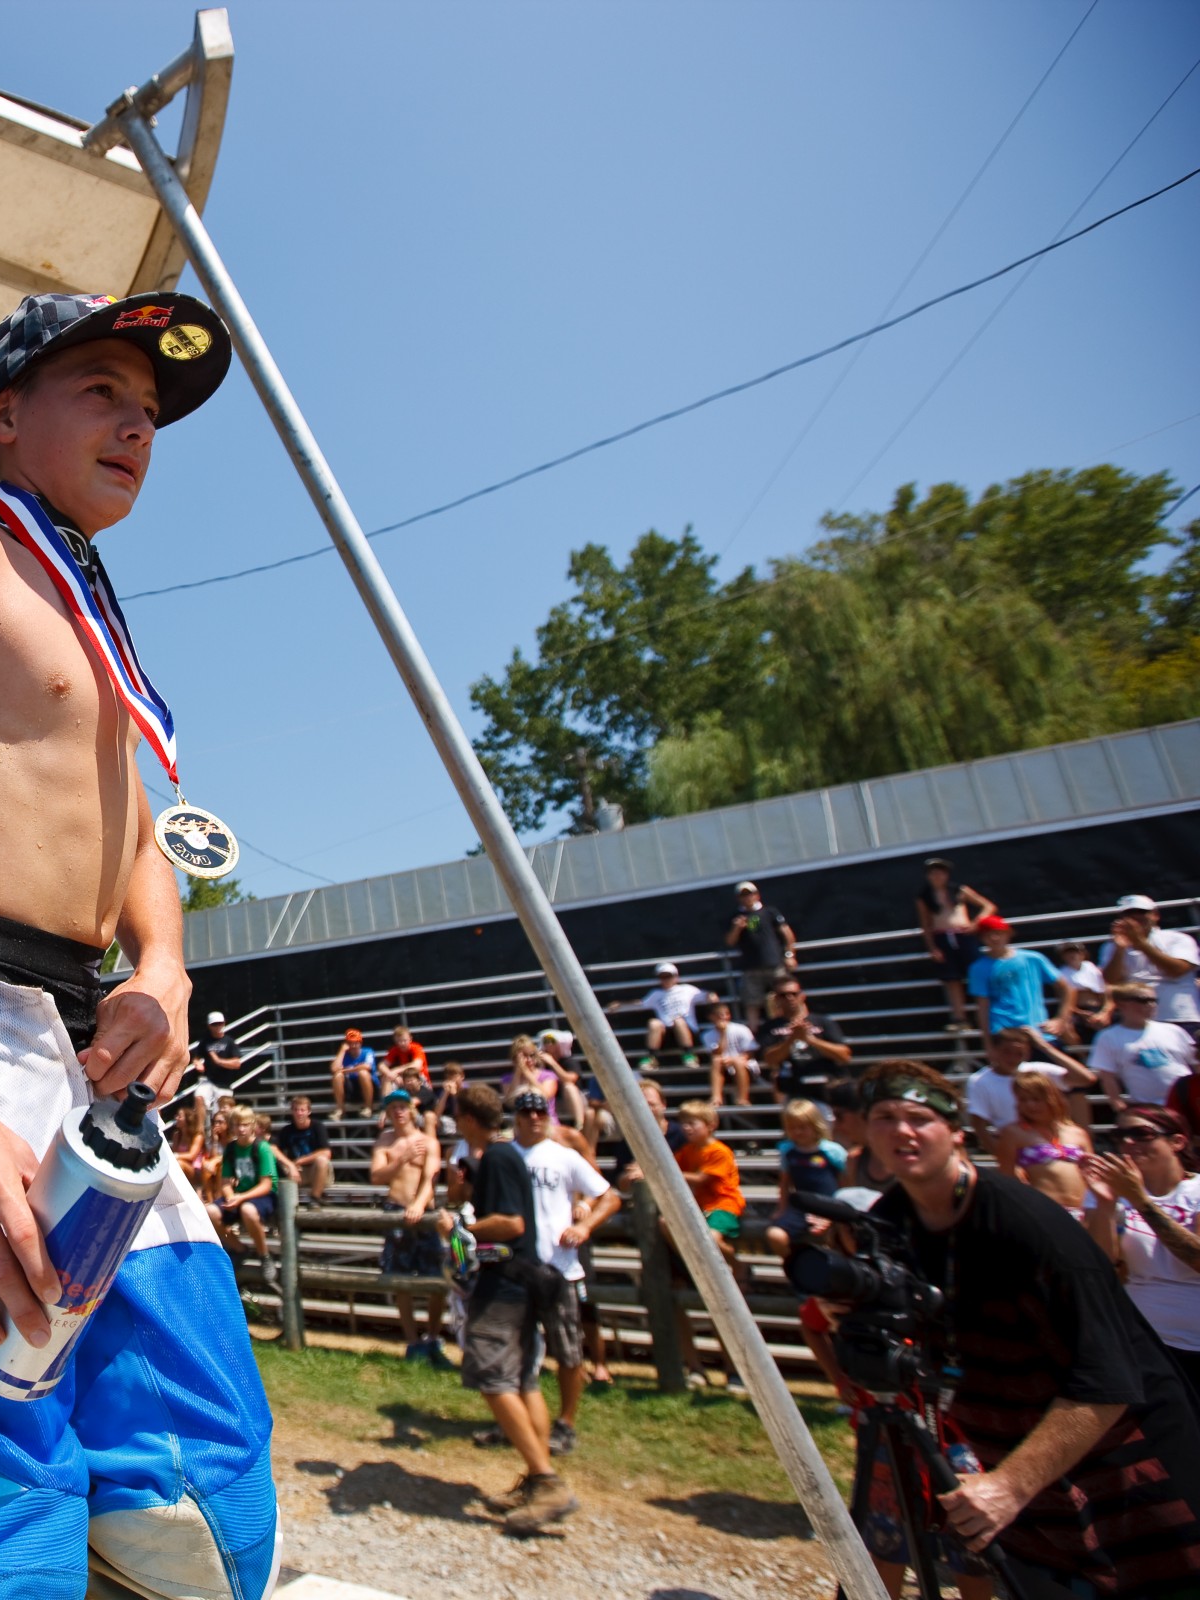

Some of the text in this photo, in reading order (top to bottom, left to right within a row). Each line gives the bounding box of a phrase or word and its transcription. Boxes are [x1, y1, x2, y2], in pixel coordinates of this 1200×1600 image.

[112, 317, 171, 330] Red Bull
[171, 843, 212, 866] 2010
